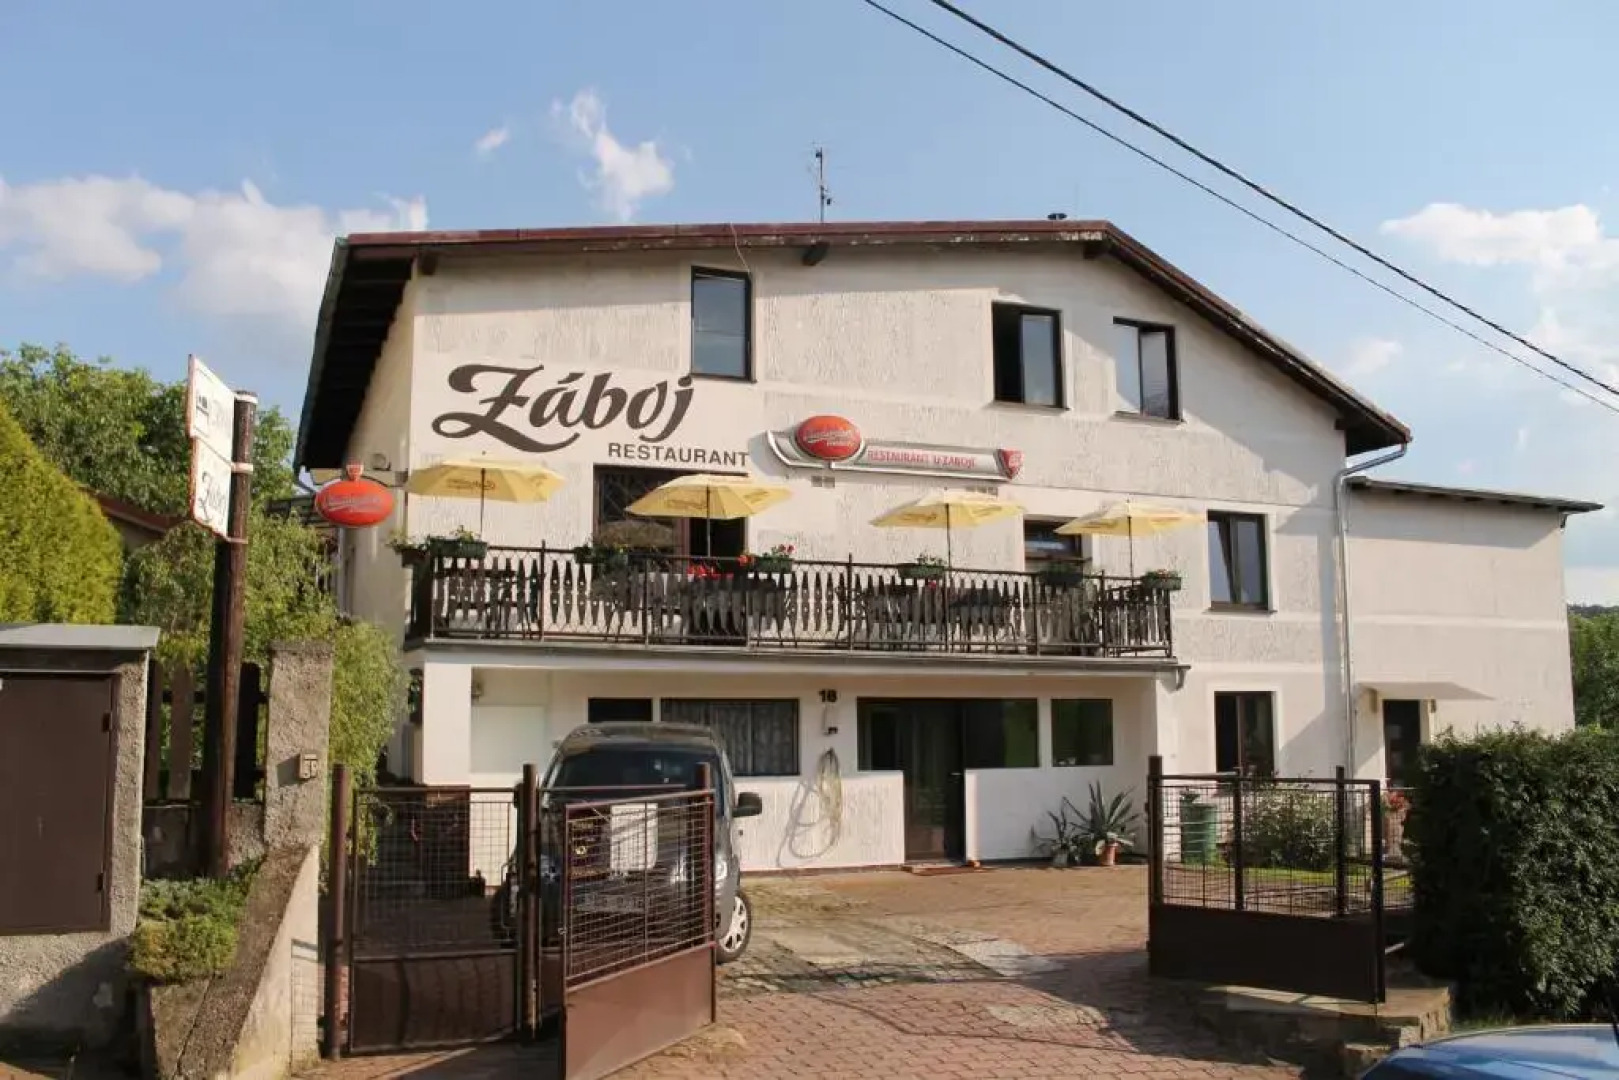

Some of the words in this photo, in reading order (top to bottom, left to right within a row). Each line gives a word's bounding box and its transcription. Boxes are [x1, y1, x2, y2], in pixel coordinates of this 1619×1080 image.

[431, 364, 695, 453] Záboj
[608, 442, 749, 467] RESTAURANT
[867, 449, 929, 463] RESTAURANT
